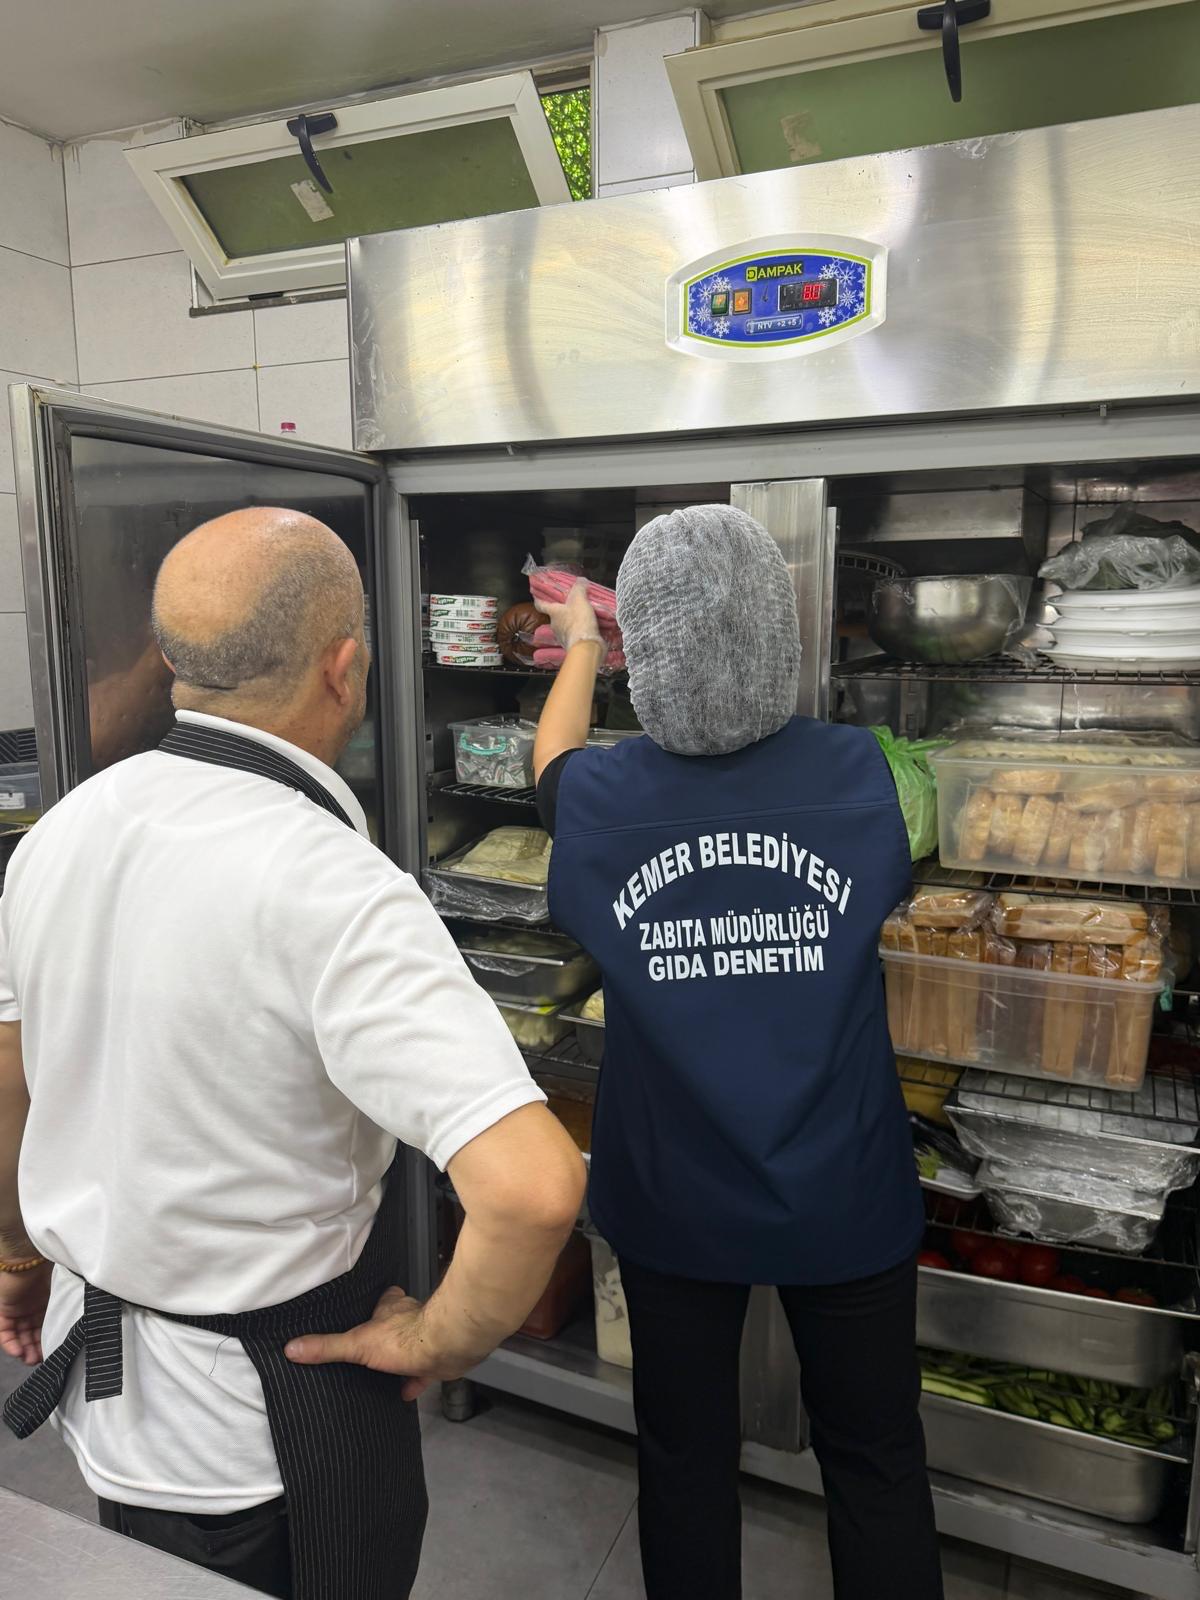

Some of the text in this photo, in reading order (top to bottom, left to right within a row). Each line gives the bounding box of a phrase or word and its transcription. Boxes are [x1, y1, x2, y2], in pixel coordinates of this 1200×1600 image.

[612, 832, 852, 931] KEMER BELEDİYESİ
[639, 904, 829, 951] ZABITA MÜDÜRLÜĞÜ
[648, 941, 825, 982] GIDA DENETİM
